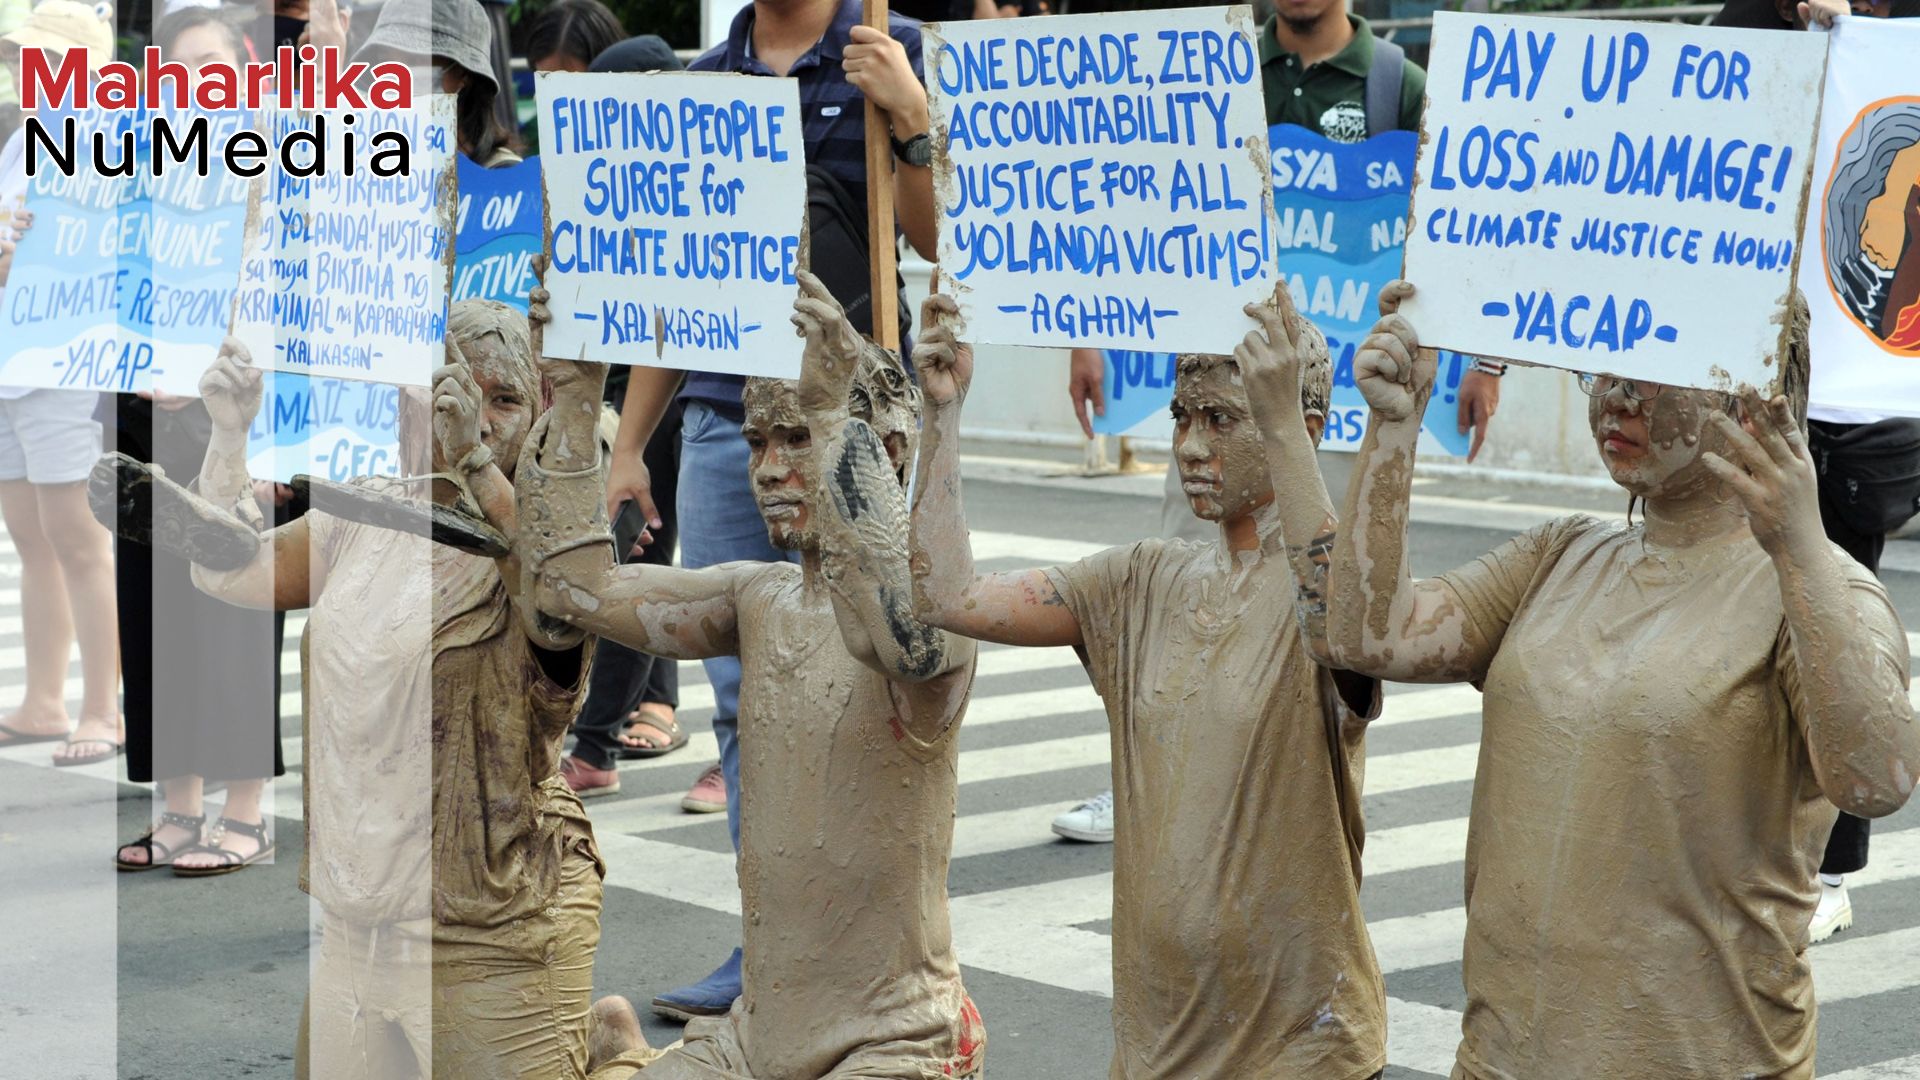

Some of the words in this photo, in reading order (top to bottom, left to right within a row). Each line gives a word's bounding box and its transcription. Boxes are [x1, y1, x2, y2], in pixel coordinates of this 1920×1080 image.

[937, 38, 1008, 97] ONE
[1016, 33, 1154, 91] DECADE,
[1158, 30, 1254, 87] ZERO
[1461, 25, 1556, 102] PAY
[1581, 32, 1650, 104] UP
[1671, 43, 1751, 102] FOR
[423, 124, 446, 154] sa
[552, 97, 674, 154] FILIPINO
[679, 98, 788, 163] PEOPLE
[948, 91, 1243, 151] ACCOUNTABILITY.
[584, 157, 690, 222] SURGE
[700, 162, 745, 217] for
[945, 158, 1095, 219] JUSTICE
[1101, 161, 1160, 208] FOR
[1170, 159, 1247, 213] ALL
[1271, 147, 1338, 192] SYA
[1366, 161, 1404, 189] SA
[1430, 125, 1540, 193] LOSS
[1542, 149, 1599, 187] AND
[1604, 131, 1793, 215] DAMAGE!
[54, 215, 88, 256] TO
[99, 211, 230, 269] GENUINE
[279, 207, 377, 252] YOLANDA!
[482, 190, 523, 232] ON
[1427, 207, 1562, 250] CLIMATE
[1571, 218, 1703, 265] JUSTICE
[1712, 230, 1793, 273] NOW!
[551, 220, 667, 277] CLIMATE
[674, 231, 799, 286] JUSTICE
[954, 220, 1120, 281] YOLANDA
[1123, 196, 1270, 288] VICTIMS!
[11, 269, 129, 326] CLIMATE
[245, 259, 265, 282] sa
[269, 258, 308, 292] mga
[316, 251, 394, 301] BIKTIMA
[404, 272, 428, 309] ng
[239, 287, 334, 335] KRIMINAL
